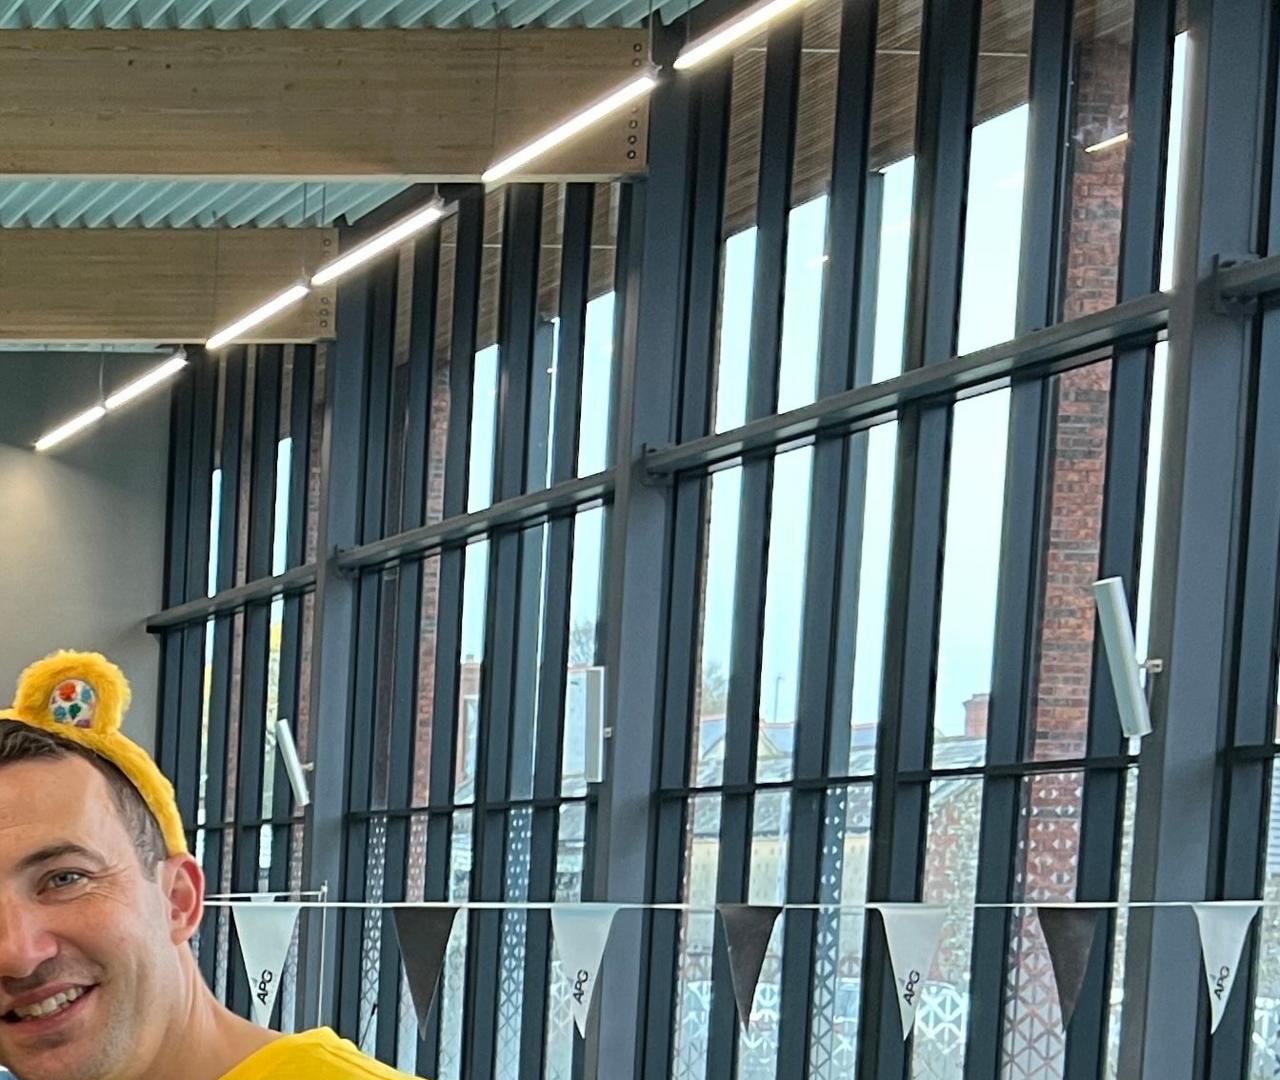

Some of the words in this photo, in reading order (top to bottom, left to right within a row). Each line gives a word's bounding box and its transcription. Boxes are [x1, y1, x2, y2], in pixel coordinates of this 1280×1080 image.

[256, 969, 273, 1006] APG
[572, 968, 589, 1005] APG
[903, 969, 920, 1006] APG
[1213, 965, 1230, 1001] APG
